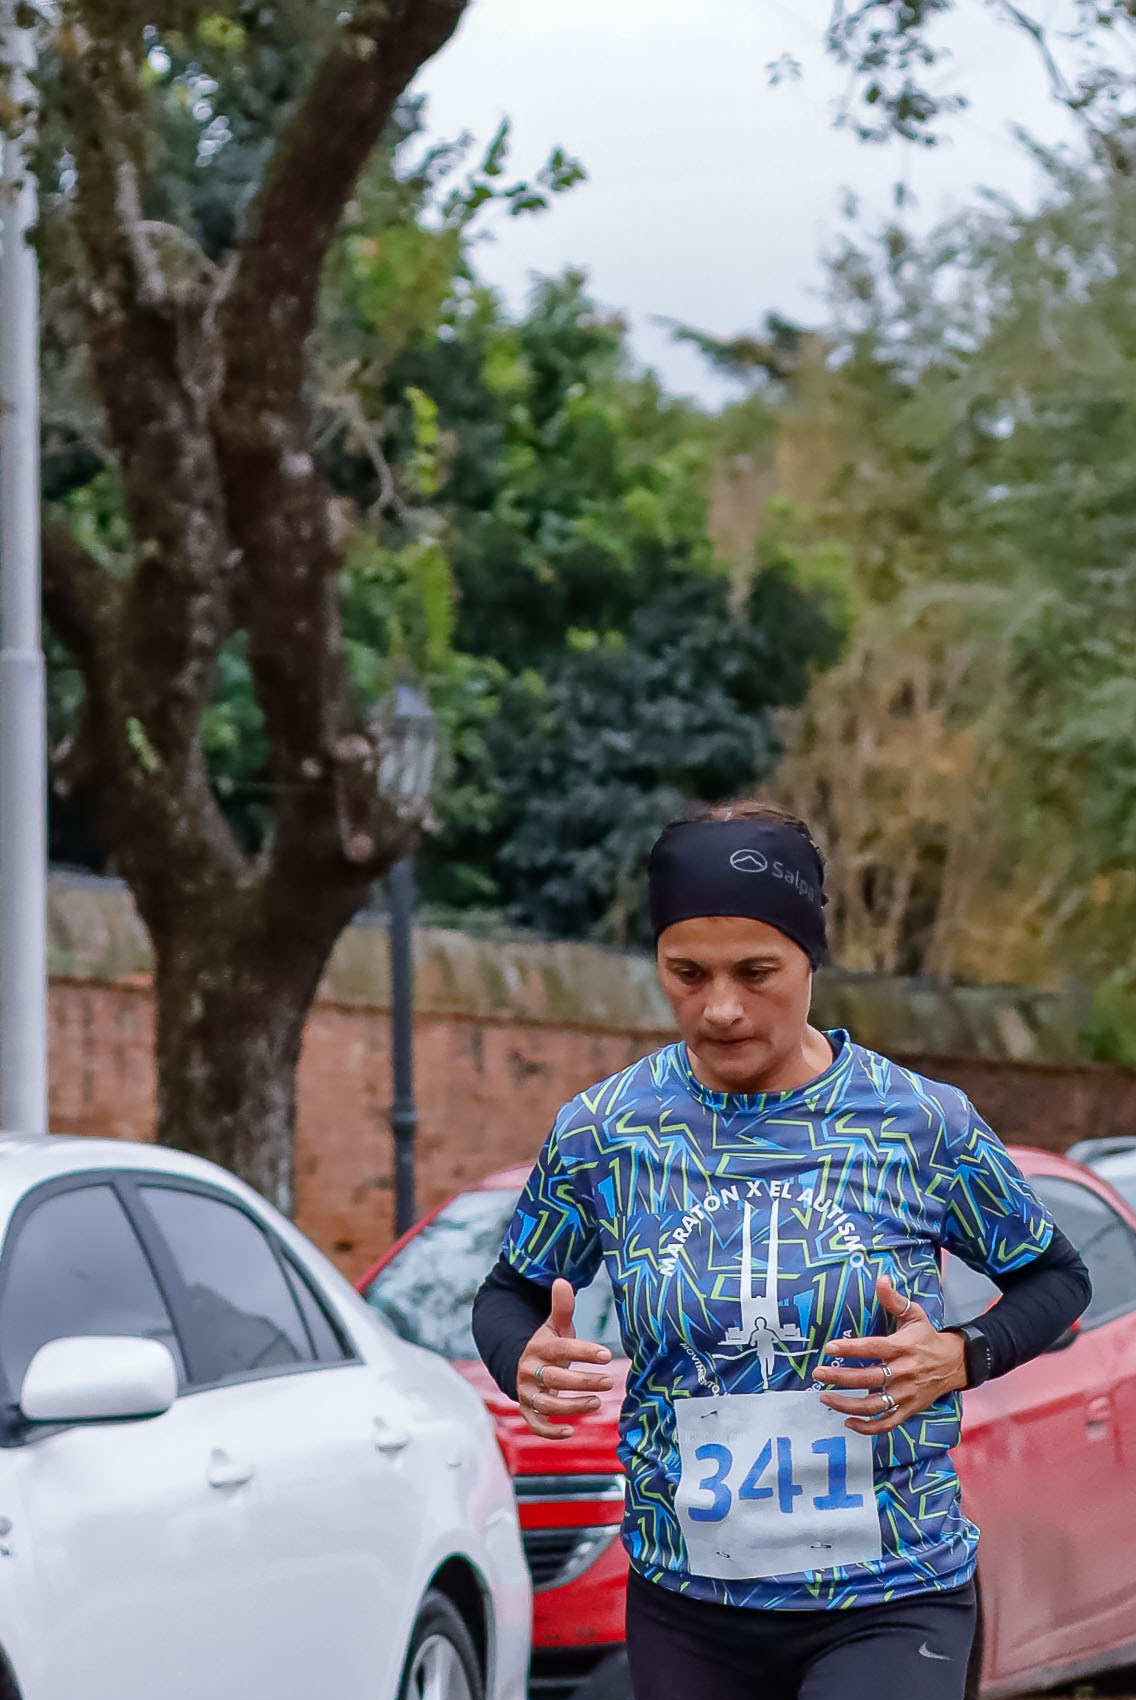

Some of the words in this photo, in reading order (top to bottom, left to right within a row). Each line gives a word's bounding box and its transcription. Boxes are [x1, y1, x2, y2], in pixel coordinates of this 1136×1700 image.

[659, 1184, 739, 1278] MARATÓN
[745, 1181, 762, 1198] X
[768, 1181, 792, 1200] EL
[796, 1187, 865, 1269] AUTISMO
[687, 1435, 864, 1523] 341
